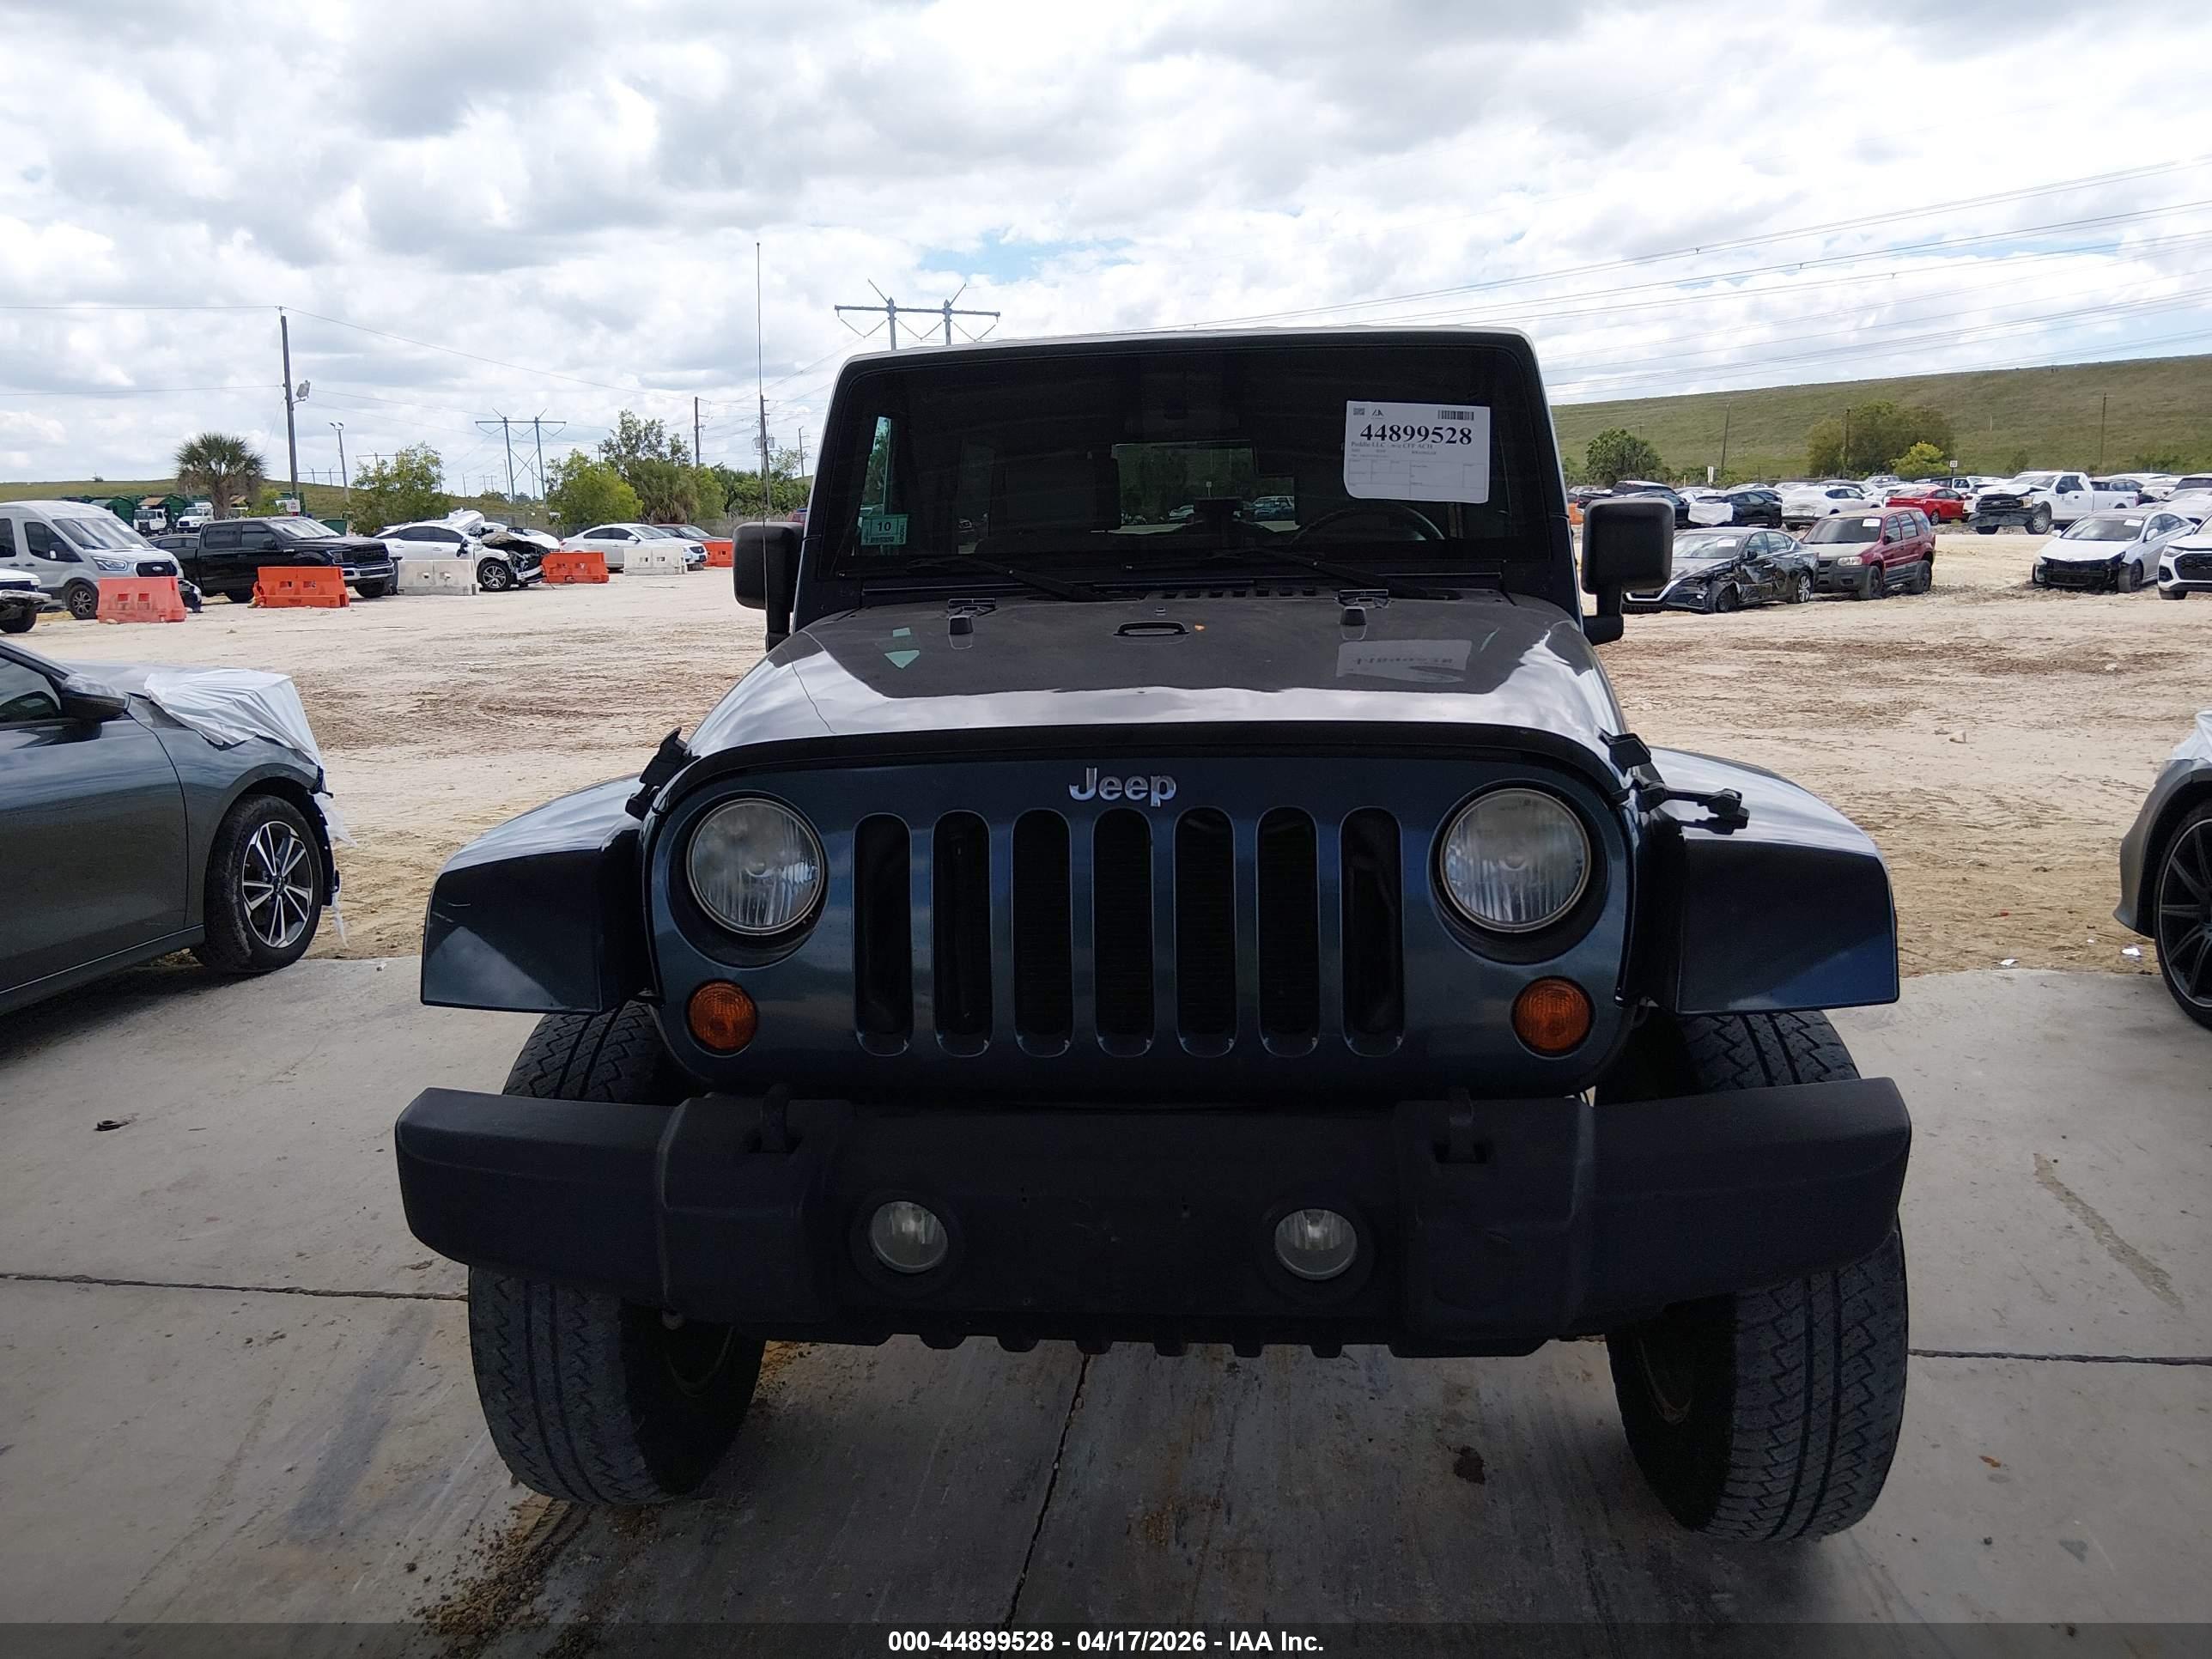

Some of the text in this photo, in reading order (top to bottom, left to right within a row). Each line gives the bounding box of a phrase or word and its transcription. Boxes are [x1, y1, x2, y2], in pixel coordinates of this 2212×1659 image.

[1360, 424, 1472, 445] 44899528
[878, 521, 891, 532] 10
[1069, 767, 1176, 807] Jeep
